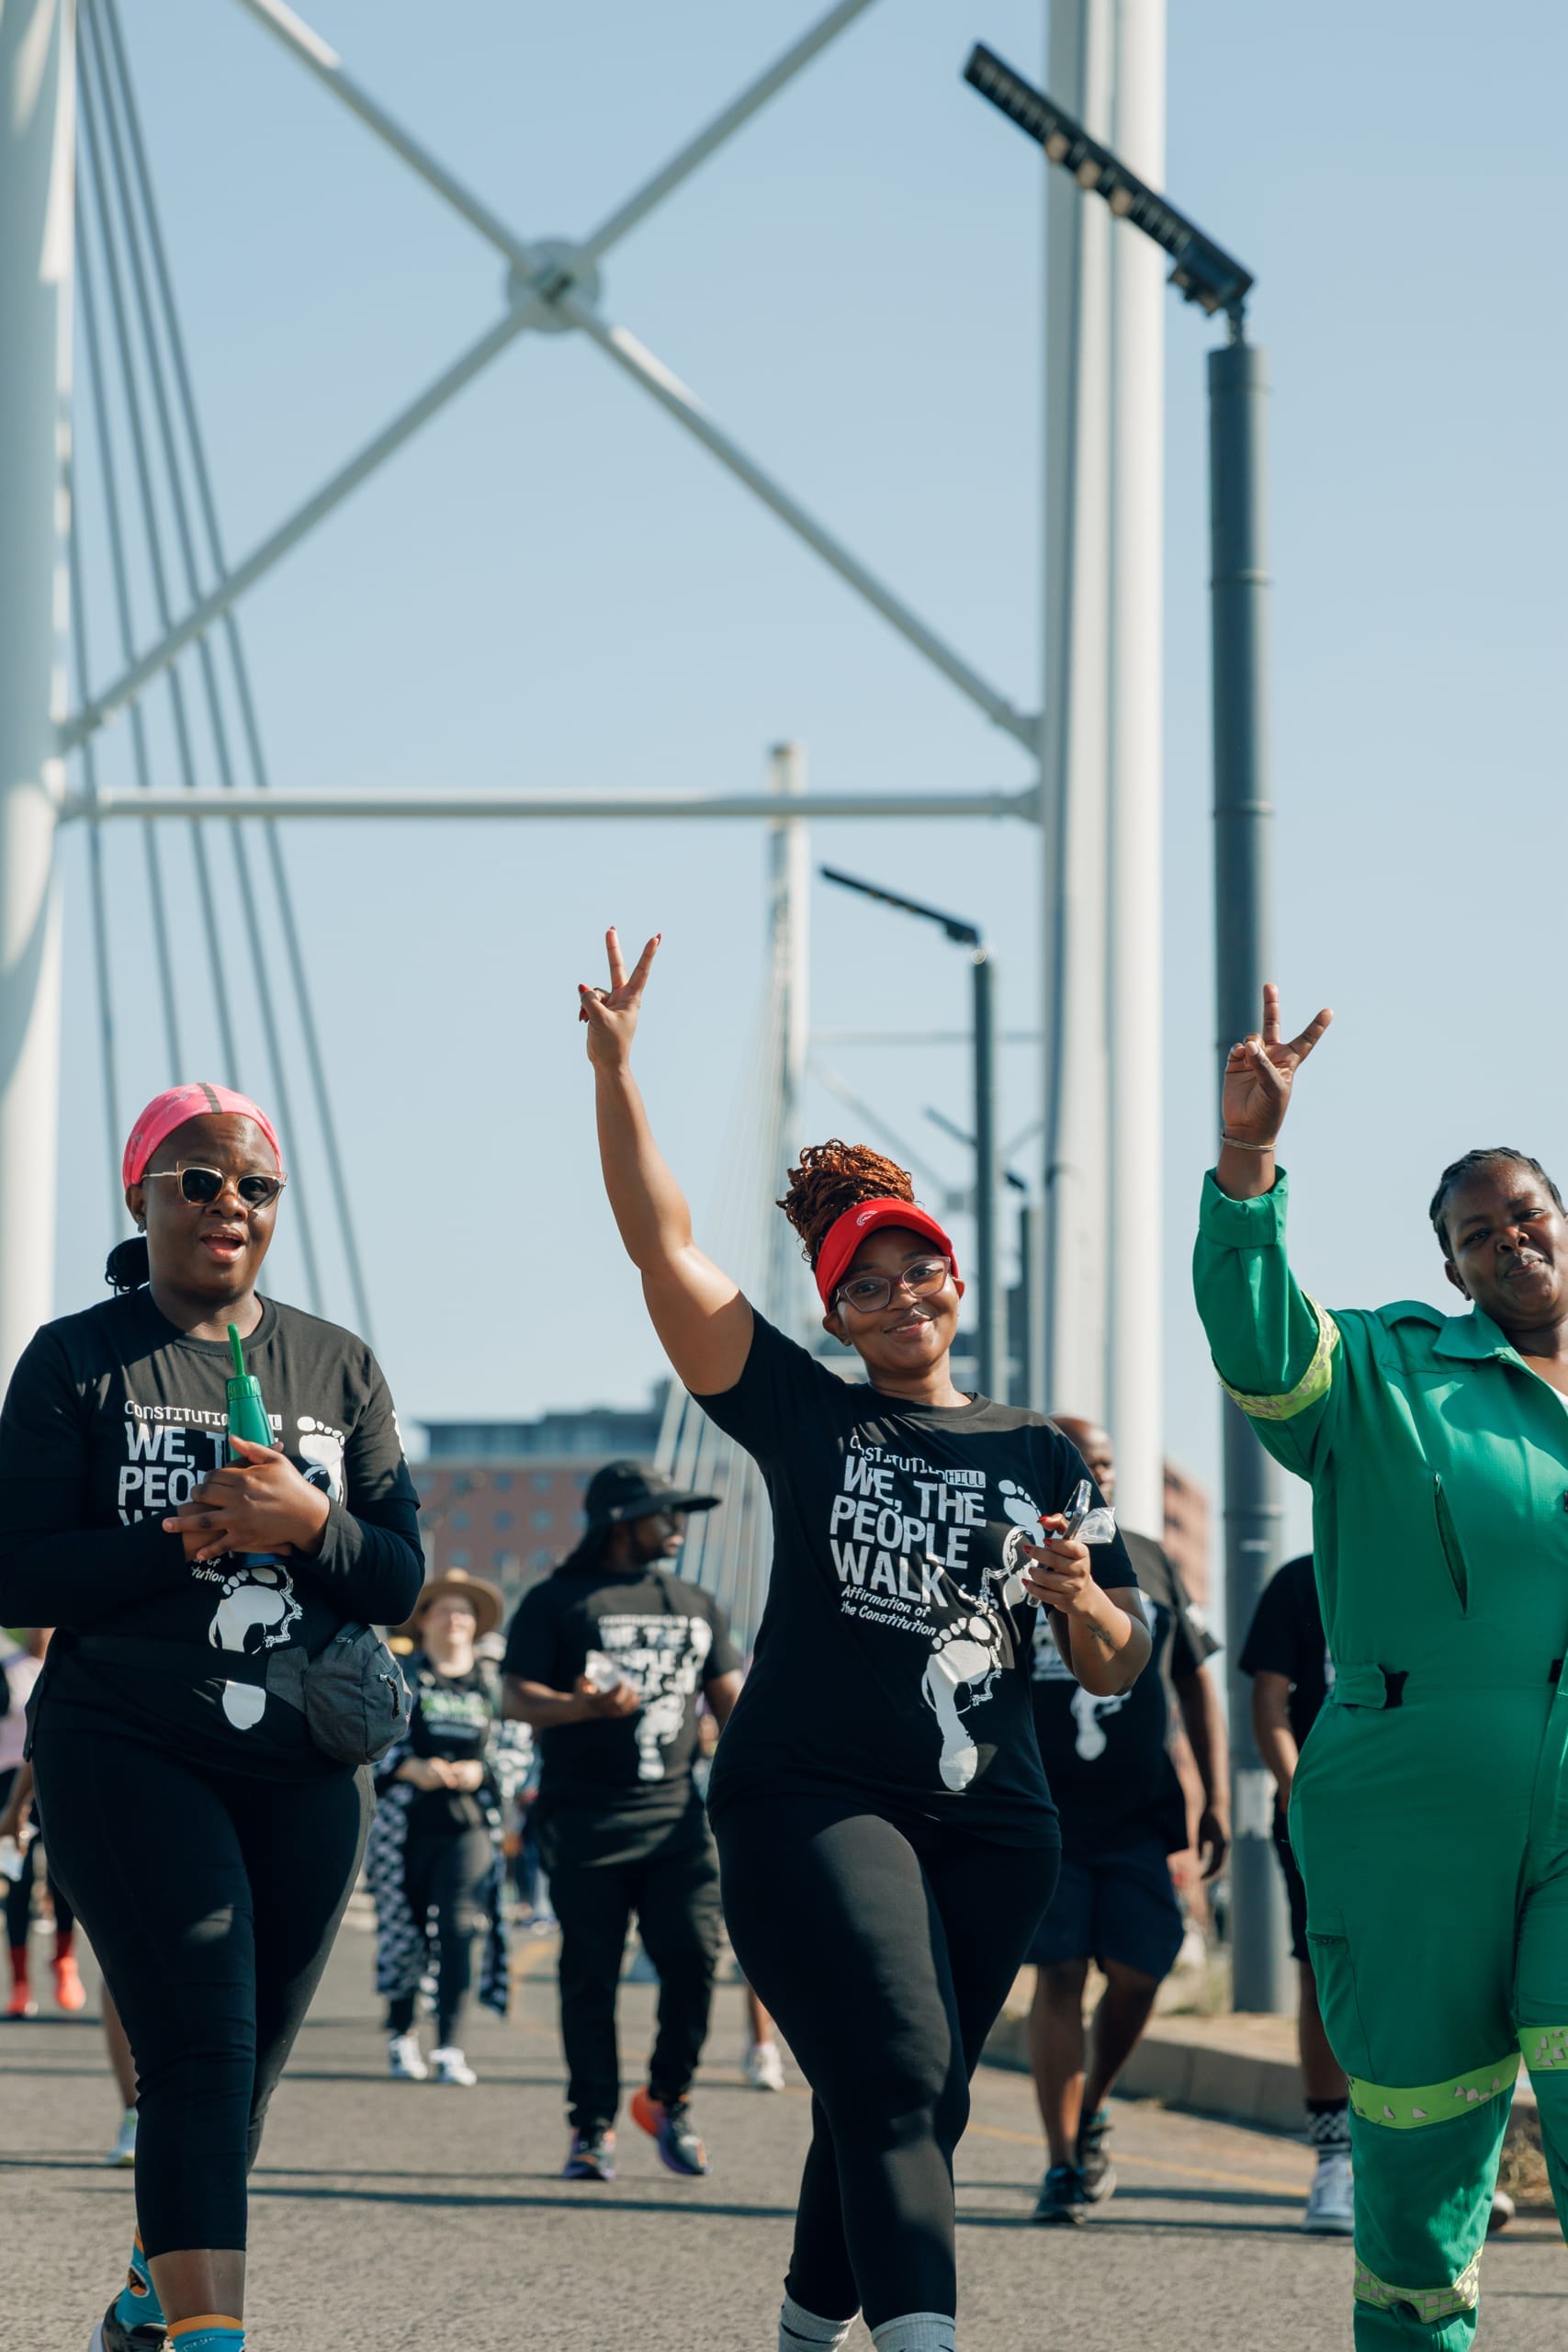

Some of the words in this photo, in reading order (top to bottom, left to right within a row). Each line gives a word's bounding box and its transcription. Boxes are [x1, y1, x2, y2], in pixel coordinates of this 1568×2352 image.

[124, 1421, 196, 1470] WE,
[118, 1465, 206, 1507] PEO
[843, 1455, 902, 1513] WE,
[913, 1480, 987, 1527] THE
[829, 1495, 970, 1568] PEOPLE
[829, 1540, 948, 1607] WALK
[840, 1600, 855, 1615] the
[859, 1605, 937, 1636] Constitution
[841, 1585, 912, 1613] Affirmation
[915, 1606, 931, 1618] of
